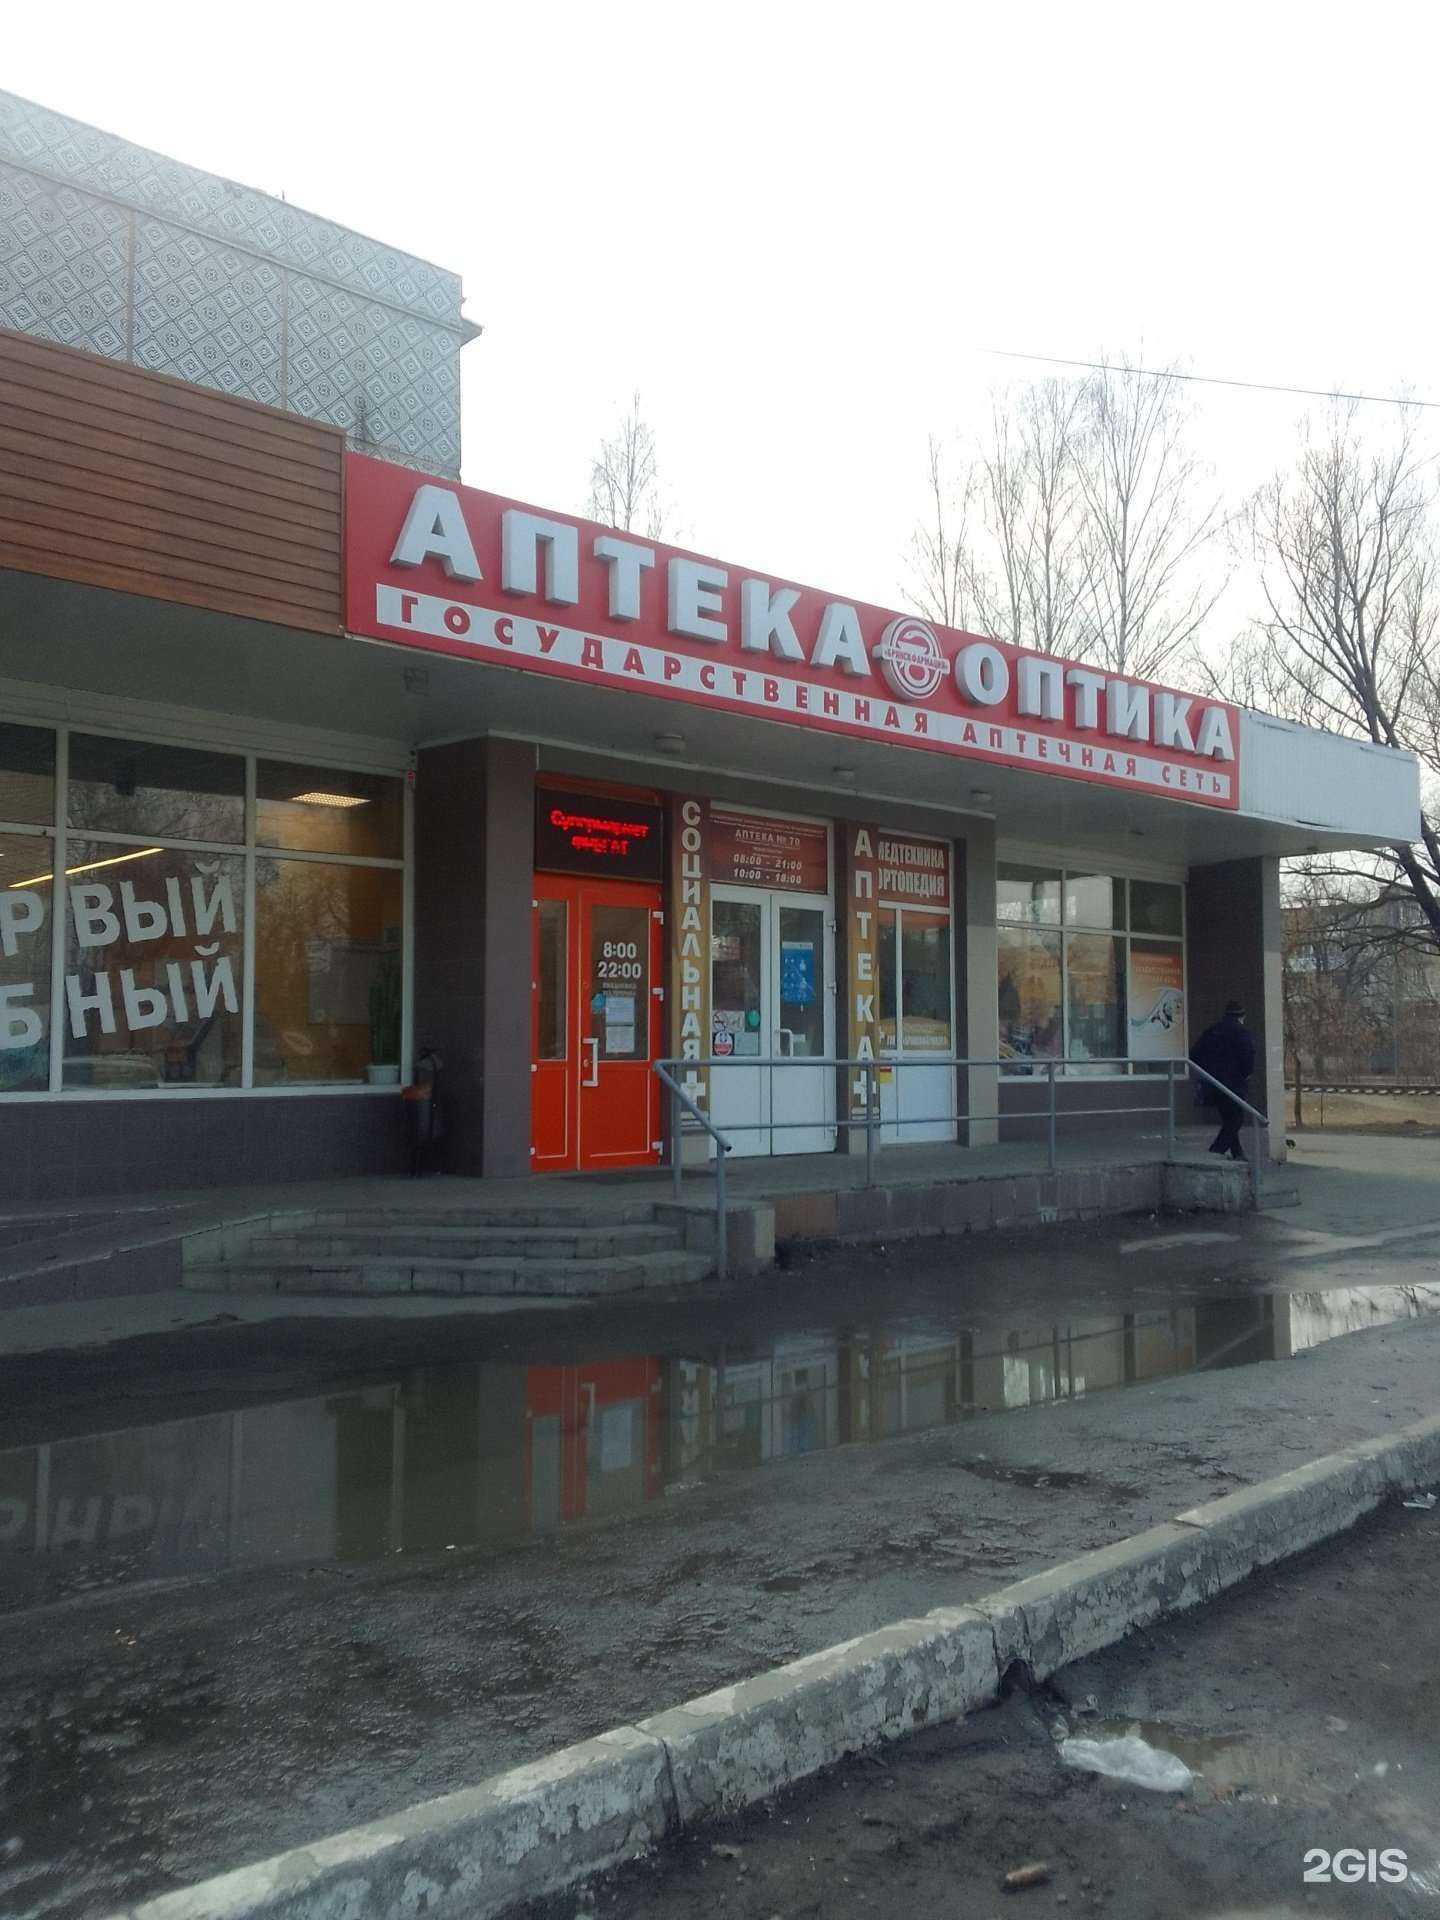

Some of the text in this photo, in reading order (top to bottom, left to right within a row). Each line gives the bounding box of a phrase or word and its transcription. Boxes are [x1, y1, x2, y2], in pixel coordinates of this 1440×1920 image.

[389, 484, 1235, 762] АПТЕКА ОПТИКА
[401, 594, 1221, 794] ГОСУДАРСТВЕННАЯ АПТЕЧНАЯ СЕТЬ
[681, 801, 702, 1061] СОЦИАЛЬНАЯ
[735, 829, 774, 843] АПТЕКА
[597, 961, 642, 979] 22:00
[603, 941, 637, 959] 8:00
[854, 829, 874, 1061] АПТЕКА
